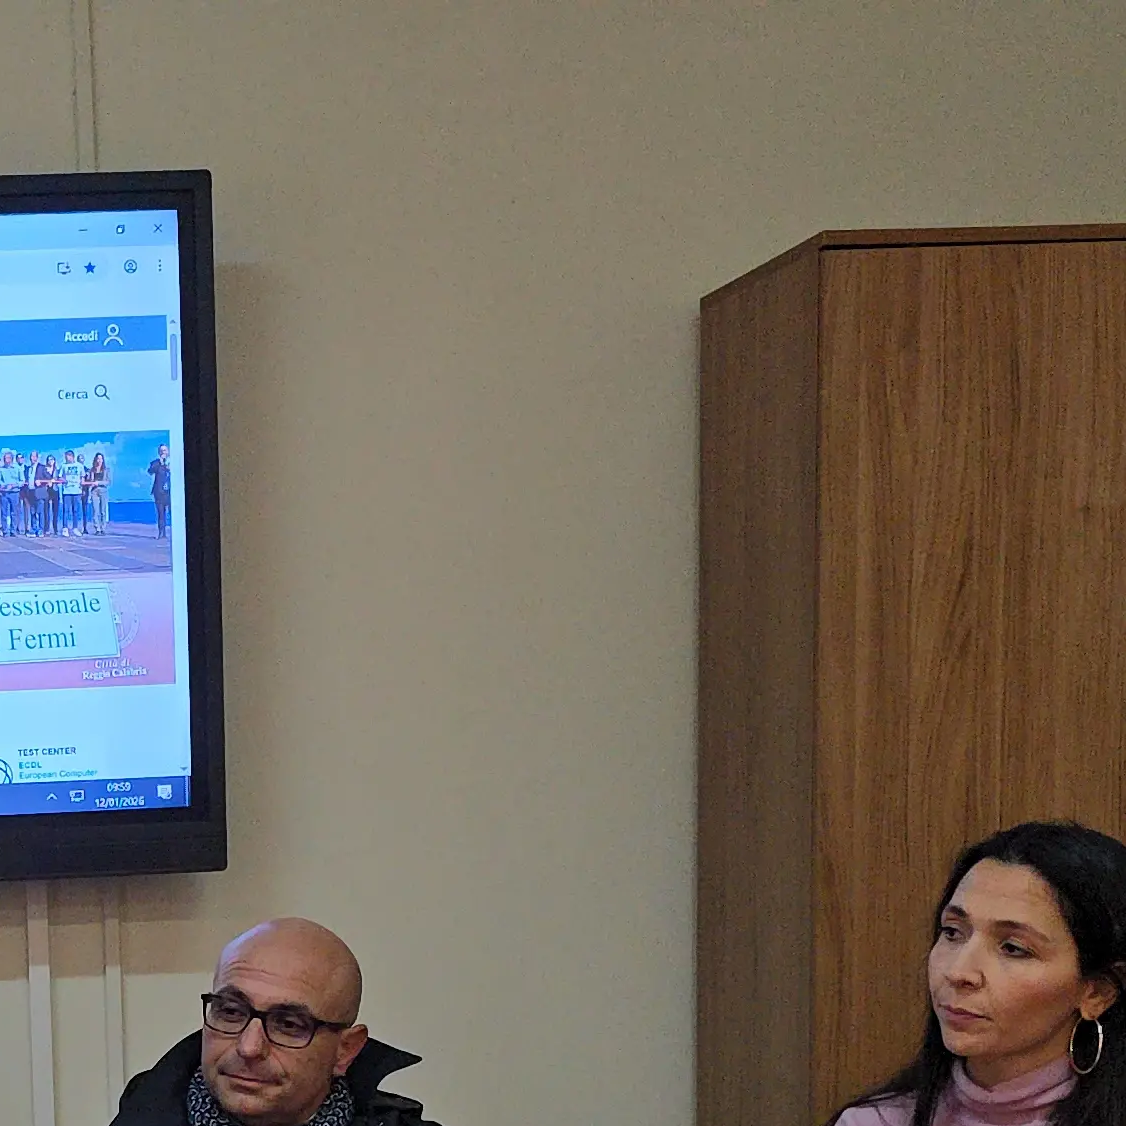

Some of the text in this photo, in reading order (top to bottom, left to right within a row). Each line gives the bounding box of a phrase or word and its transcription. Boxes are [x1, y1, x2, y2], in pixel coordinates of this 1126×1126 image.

[64, 330, 99, 343] Accedi
[58, 388, 88, 401] Cerca
[8, 625, 77, 653] Fermi
[18, 747, 77, 757] TEST CENTER
[18, 762, 43, 770] ECDL
[19, 769, 98, 781] European Computer
[95, 796, 145, 808] 12/01/2026
